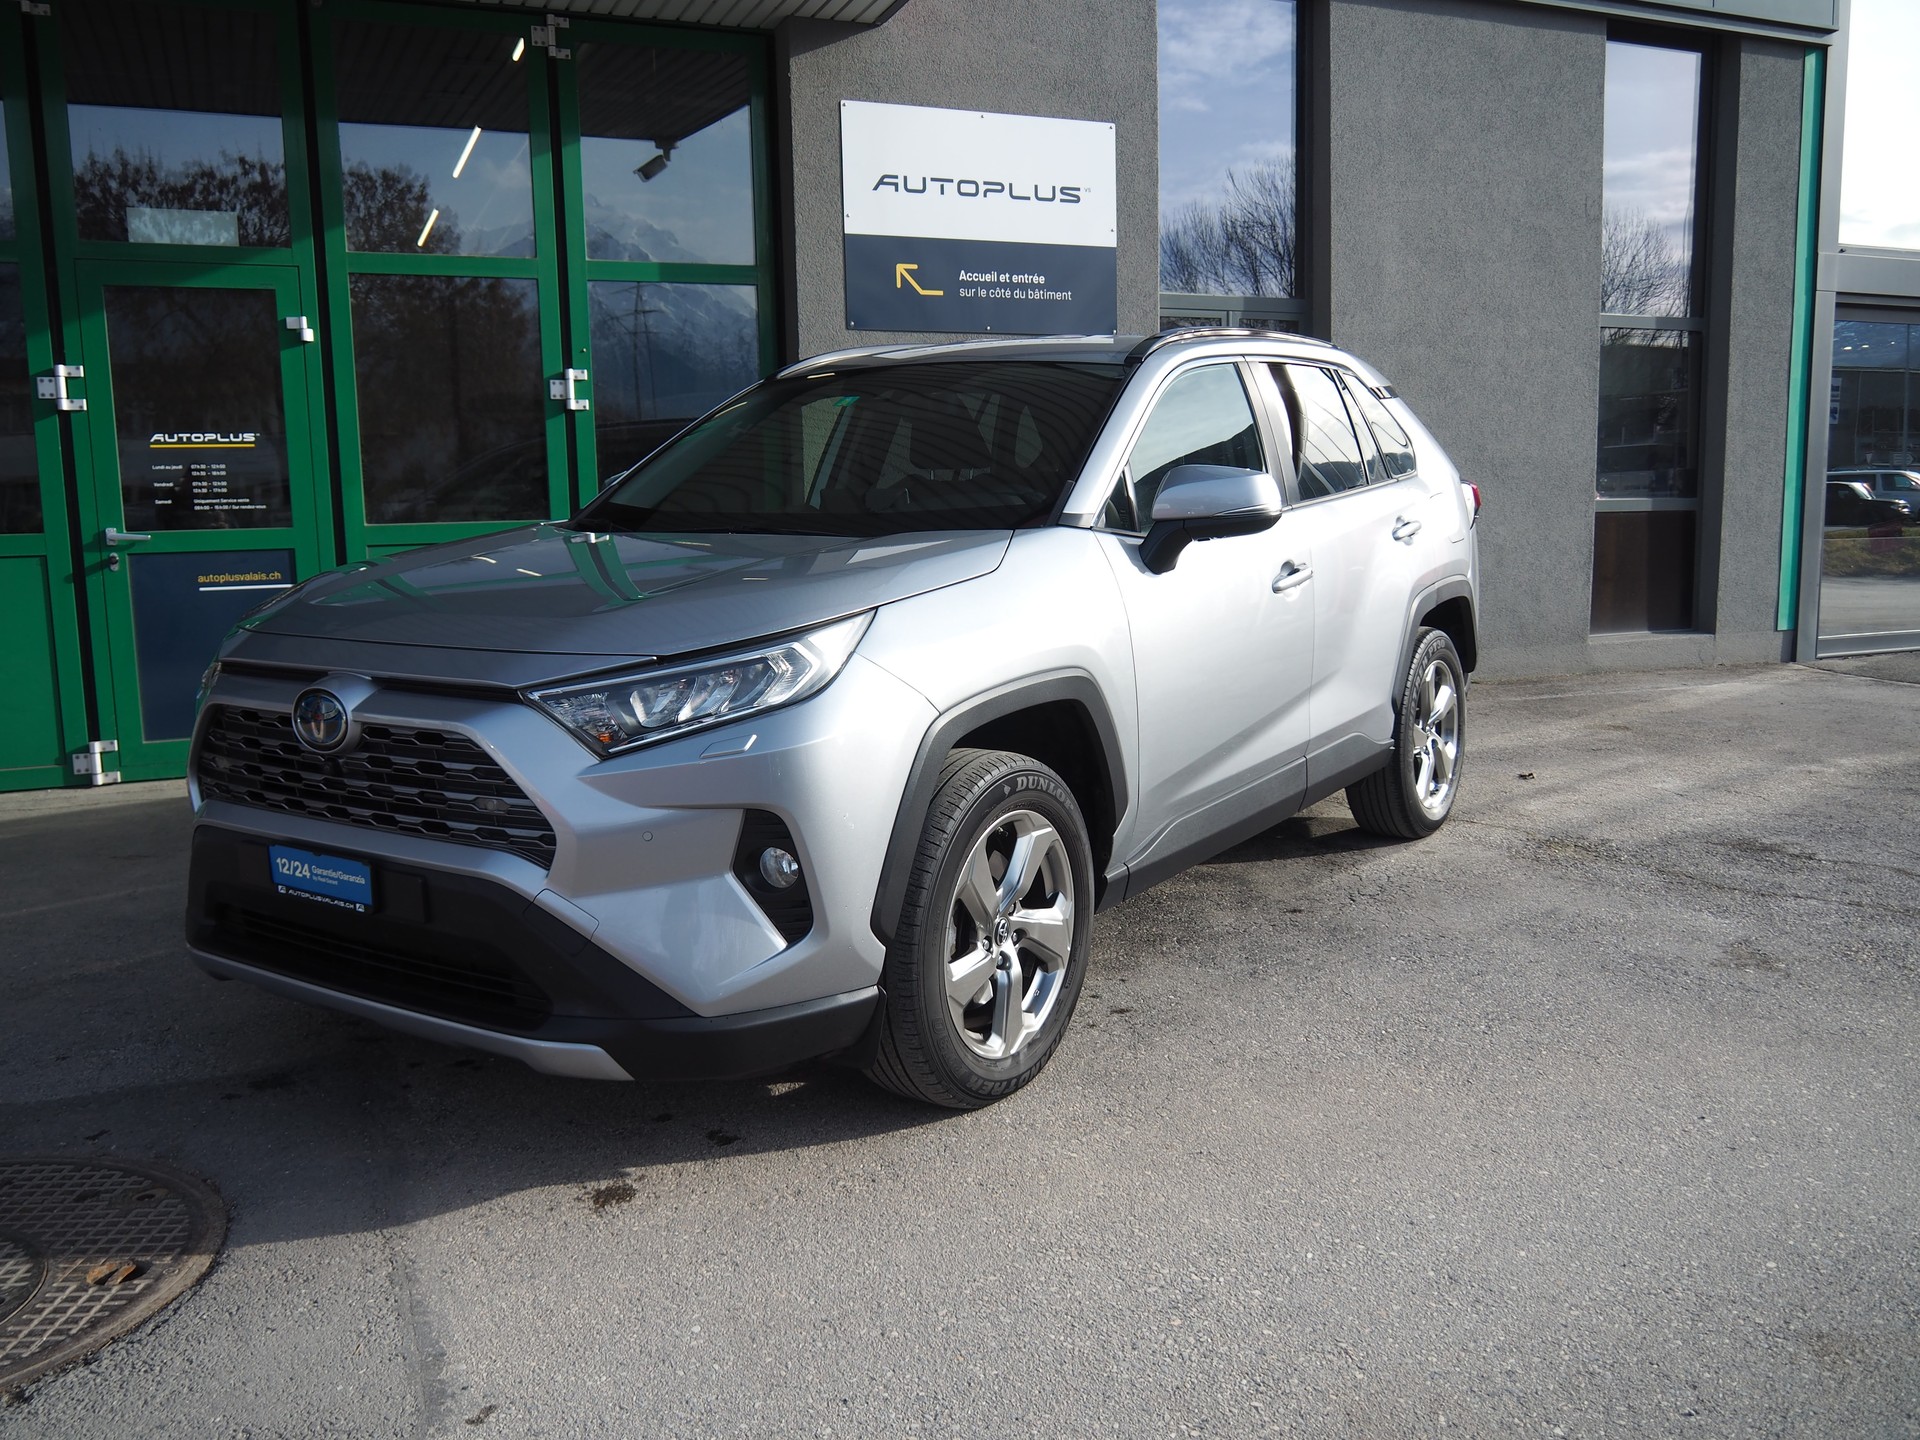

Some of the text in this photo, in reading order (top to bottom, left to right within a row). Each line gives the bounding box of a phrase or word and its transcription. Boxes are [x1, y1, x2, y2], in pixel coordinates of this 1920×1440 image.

[872, 174, 1081, 204] AUTOPLUS
[959, 270, 1045, 284] Accueil et entrée
[959, 286, 1072, 300] sur le côté du bâtiment
[150, 433, 256, 442] AUTOPLUS
[197, 571, 281, 583] autoplusvalais.ch
[1015, 775, 1075, 811] DUNLOP
[276, 857, 365, 885] 12/24 Garantie/Garanzia
[288, 890, 354, 909] AUTOPLUSVALAIS.CH
